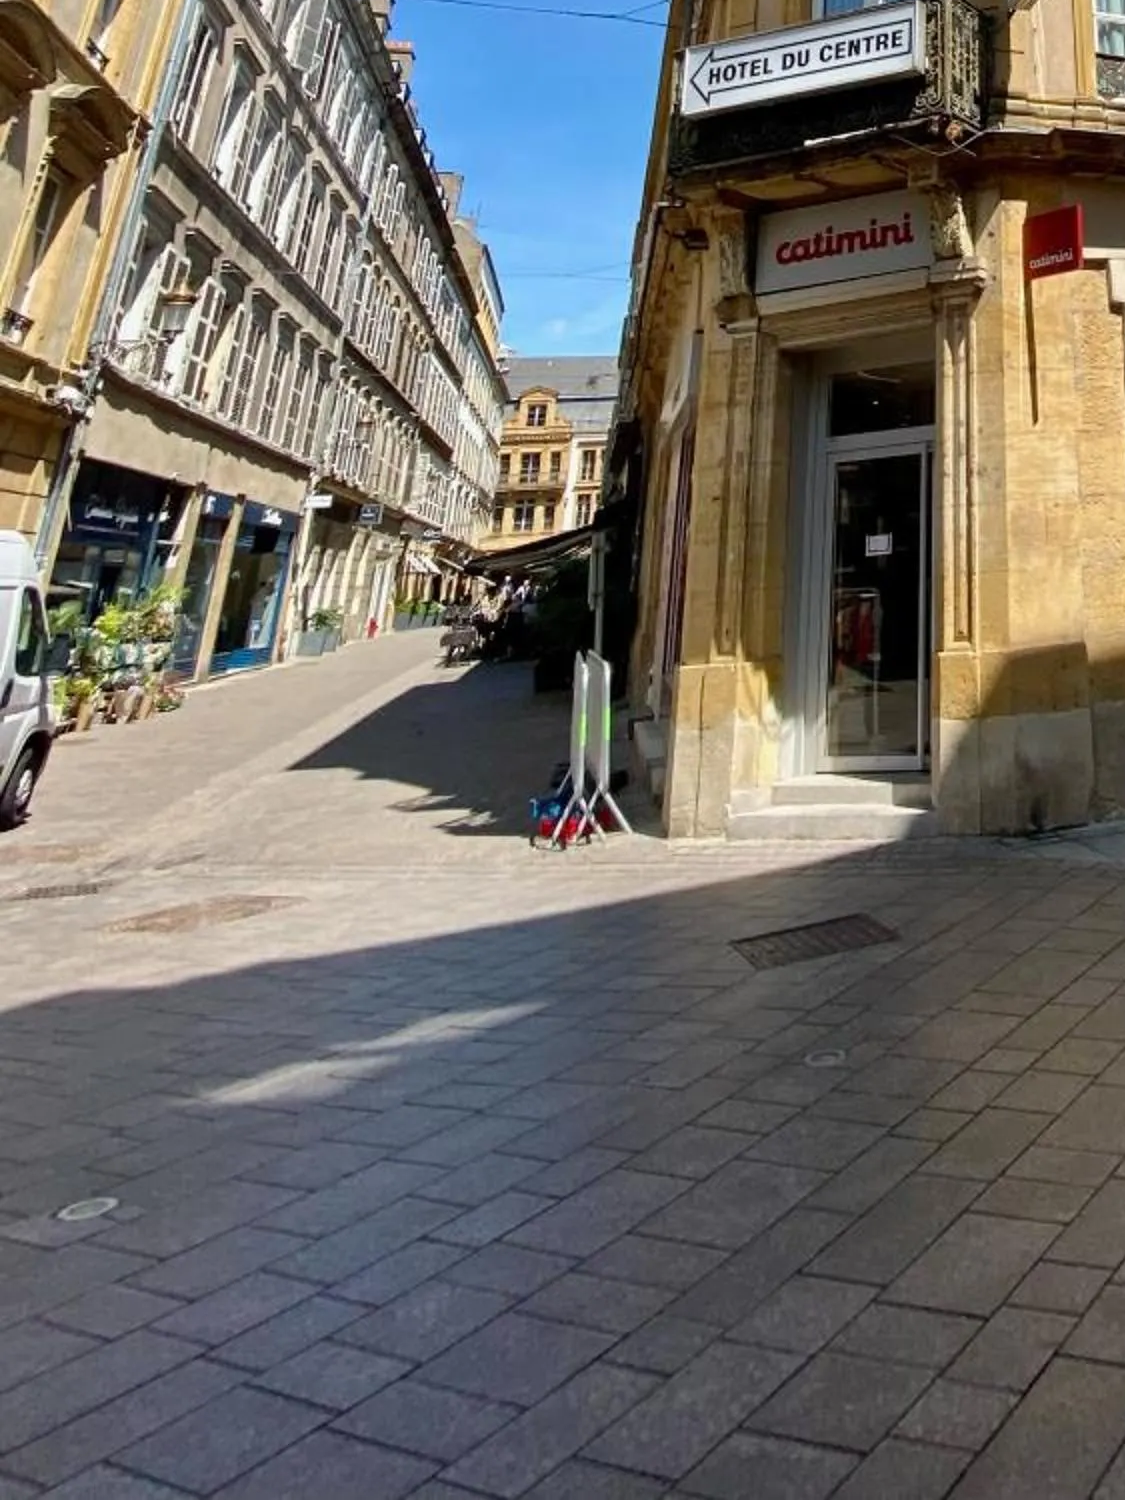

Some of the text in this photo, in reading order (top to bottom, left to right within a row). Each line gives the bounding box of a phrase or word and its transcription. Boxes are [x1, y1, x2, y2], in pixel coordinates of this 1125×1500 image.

[707, 29, 904, 85] HOTEL DU CENTRE
[775, 212, 914, 265] catimini
[1029, 247, 1074, 270] catimini
